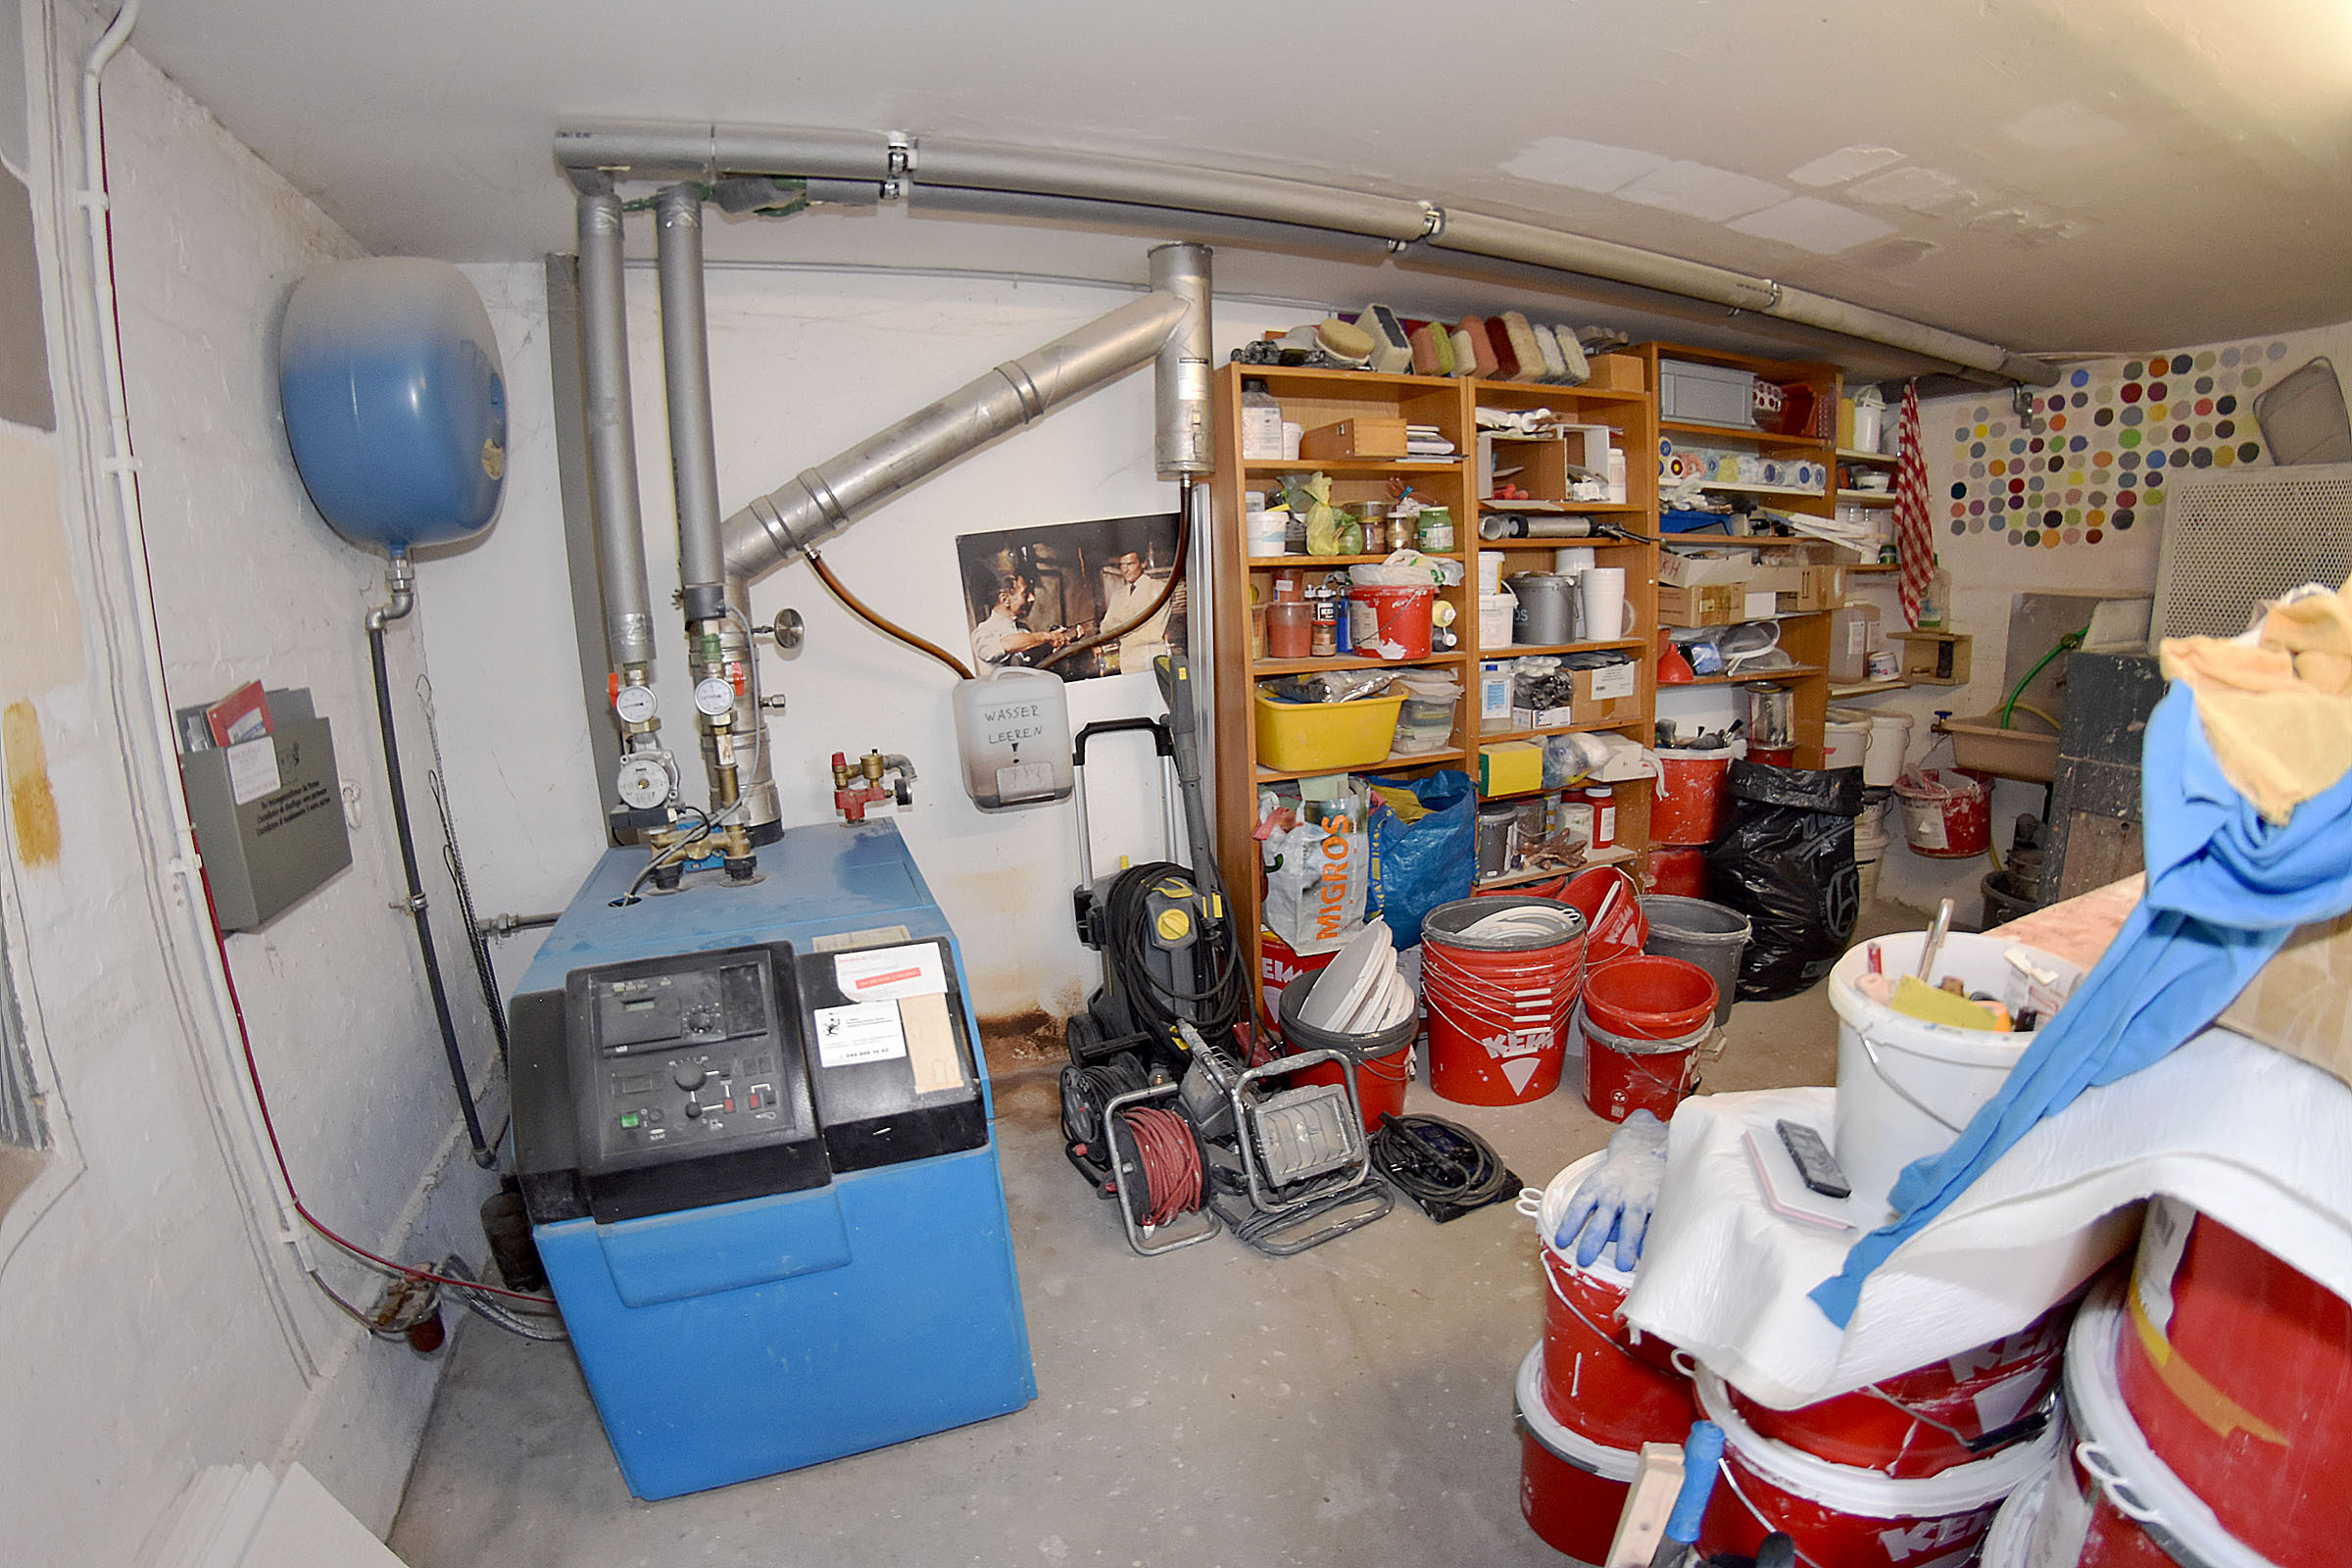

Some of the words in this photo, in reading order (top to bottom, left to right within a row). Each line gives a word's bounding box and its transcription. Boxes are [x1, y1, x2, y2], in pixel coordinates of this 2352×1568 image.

[984, 705, 1040, 722] WASSER
[988, 725, 1044, 745] LEEREN
[1316, 814, 1349, 942] MIGROS
